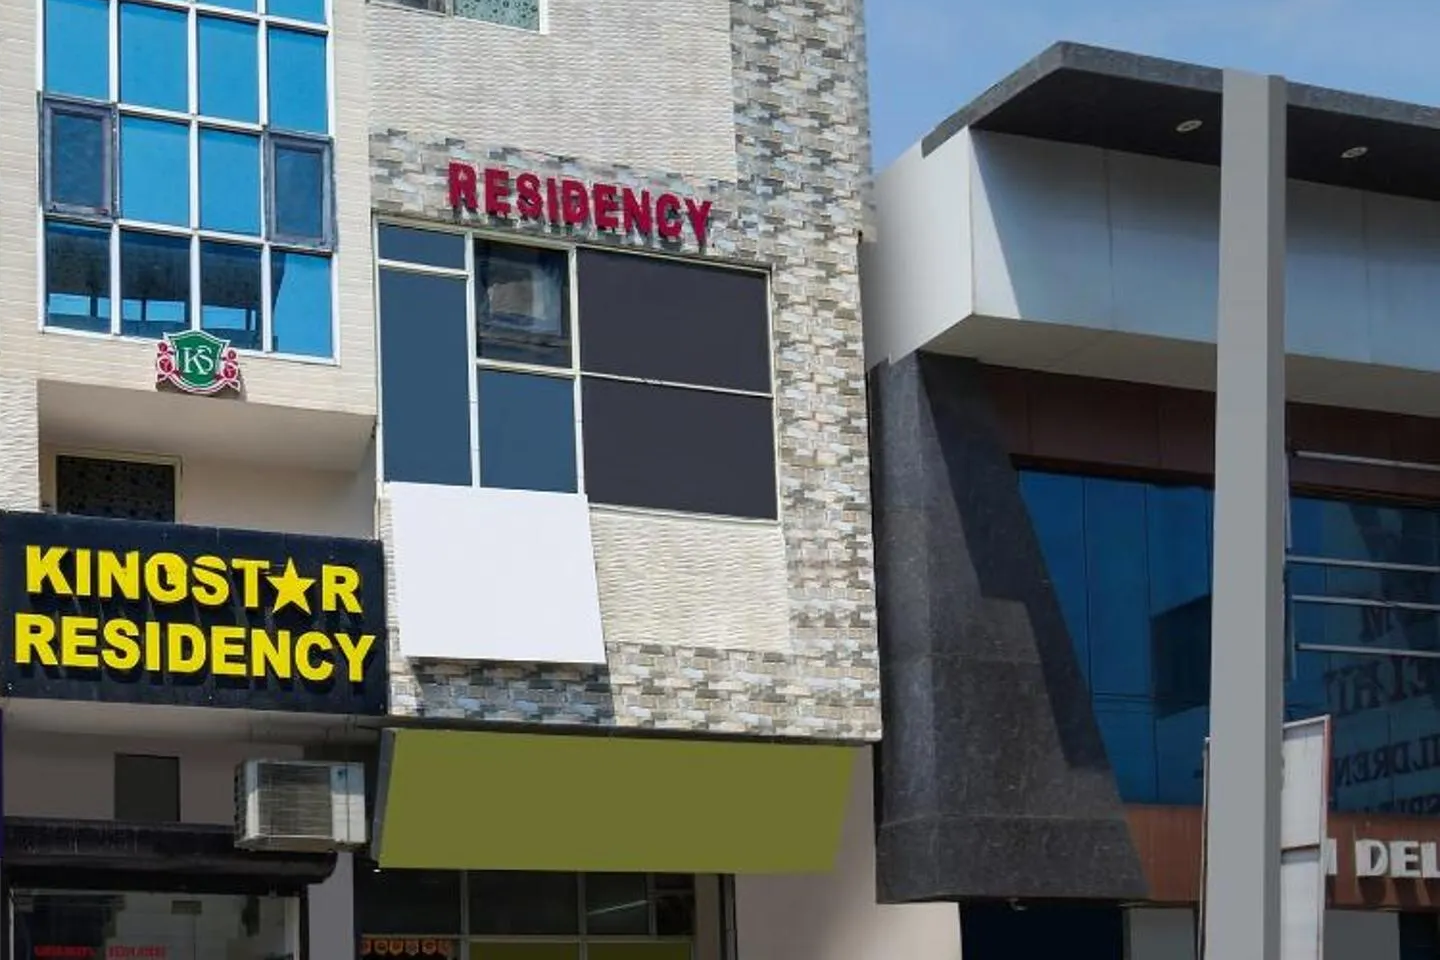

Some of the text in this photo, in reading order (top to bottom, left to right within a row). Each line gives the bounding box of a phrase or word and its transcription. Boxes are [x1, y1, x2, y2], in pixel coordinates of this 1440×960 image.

[448, 160, 713, 247] RESIDENCY
[182, 345, 214, 375] KS
[14, 612, 375, 682] RESIDENCY
